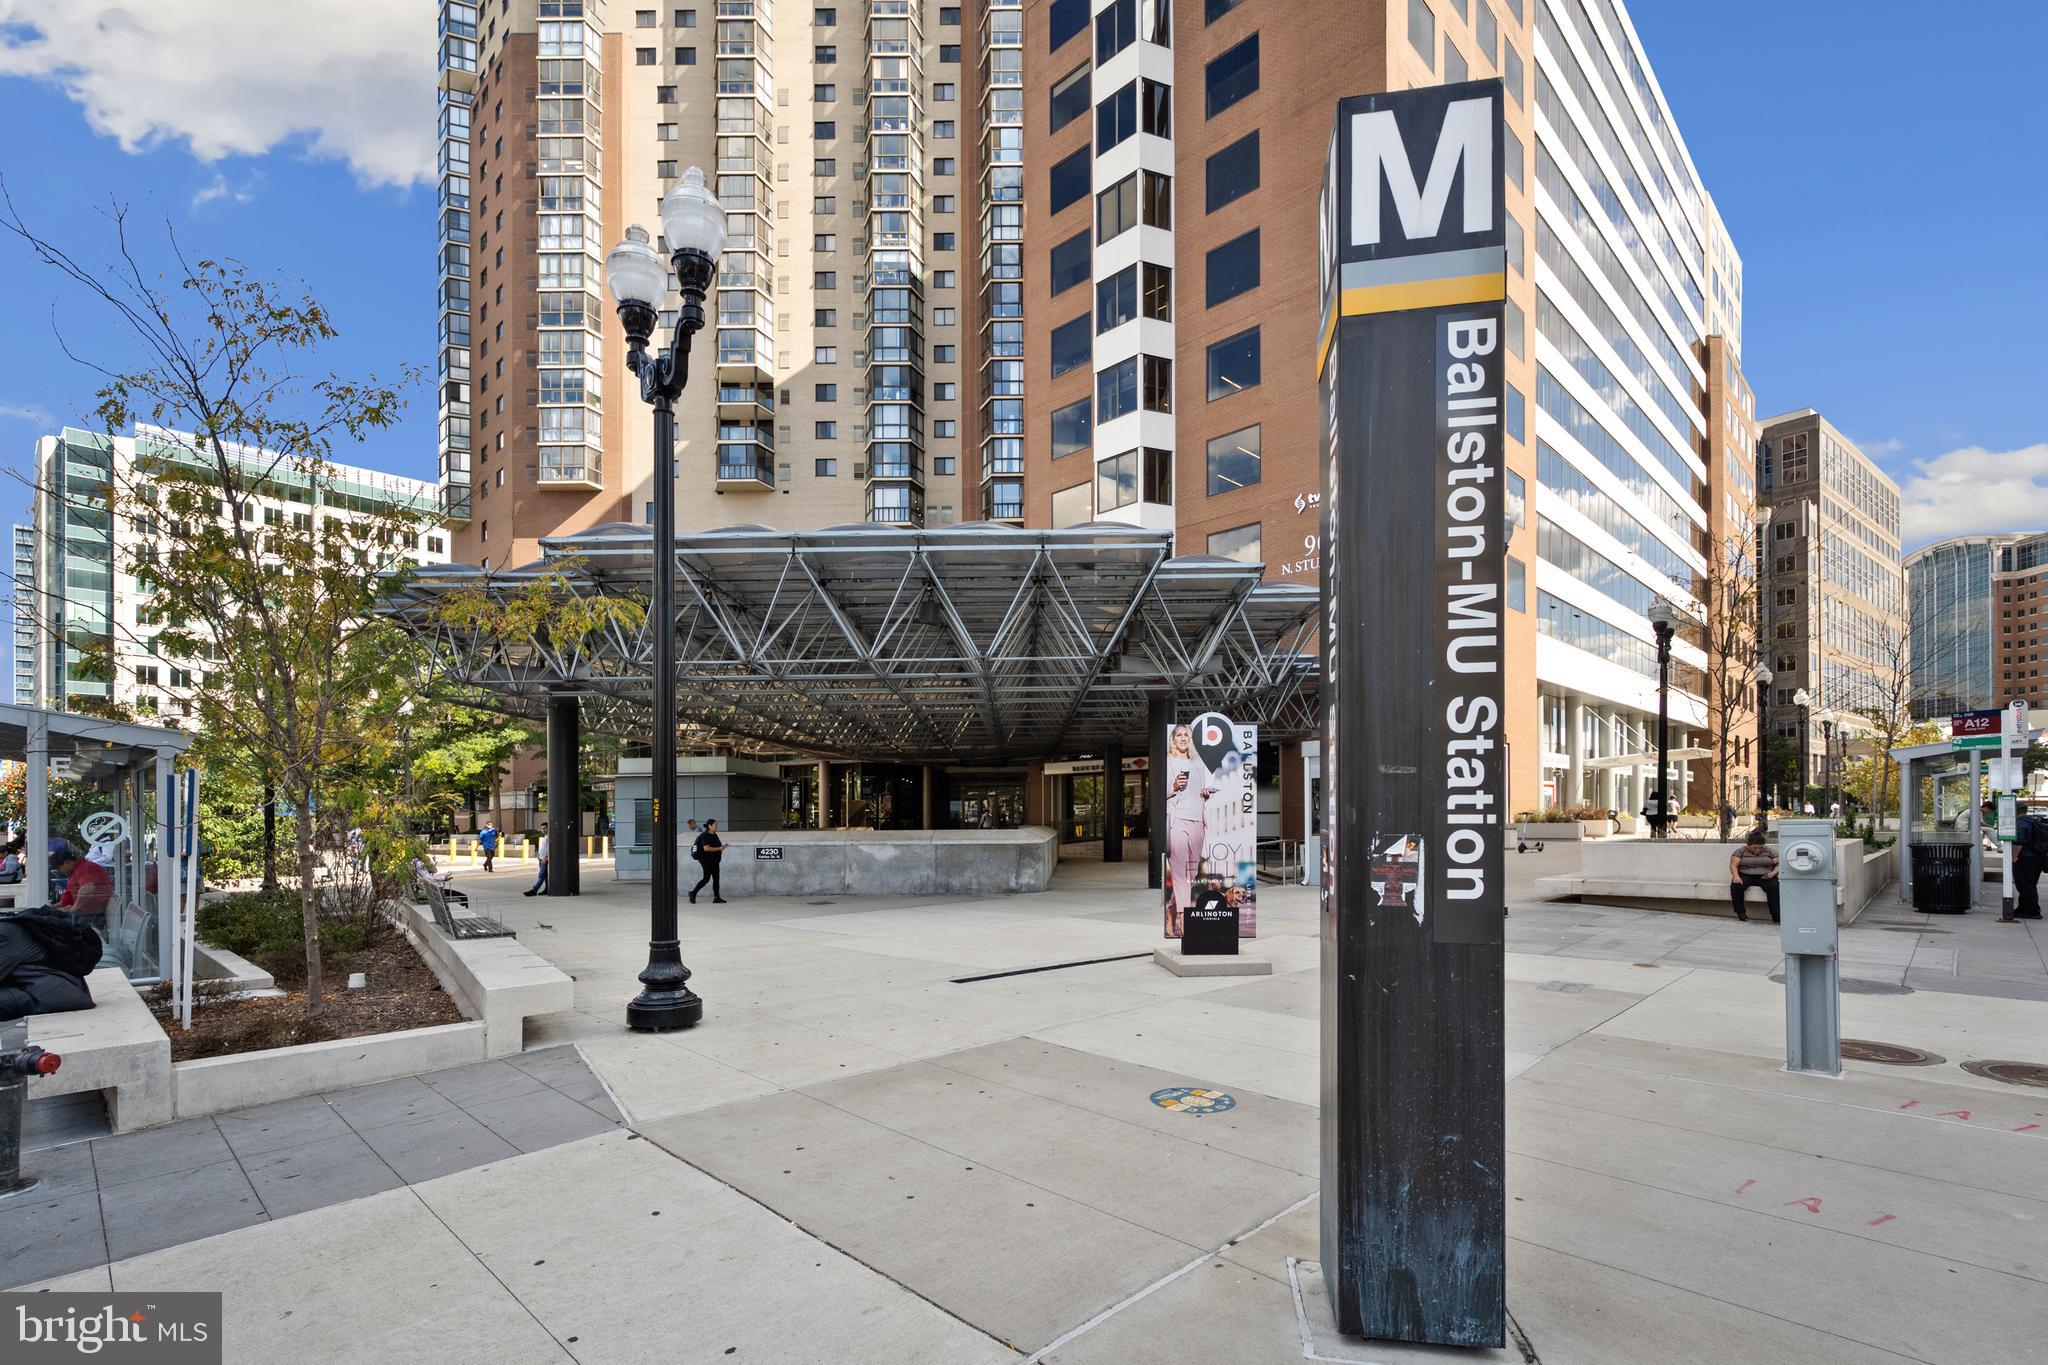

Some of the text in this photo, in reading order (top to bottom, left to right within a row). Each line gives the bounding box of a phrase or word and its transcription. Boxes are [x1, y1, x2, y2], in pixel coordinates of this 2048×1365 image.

[1351, 97, 1493, 246] M
[1281, 563, 1293, 576] N.
[1446, 316, 1498, 902] Ballston-MU Station
[1964, 718, 1990, 728] A12
[1242, 730, 1254, 814] BALLSTON
[1204, 843, 1242, 860] JOY
